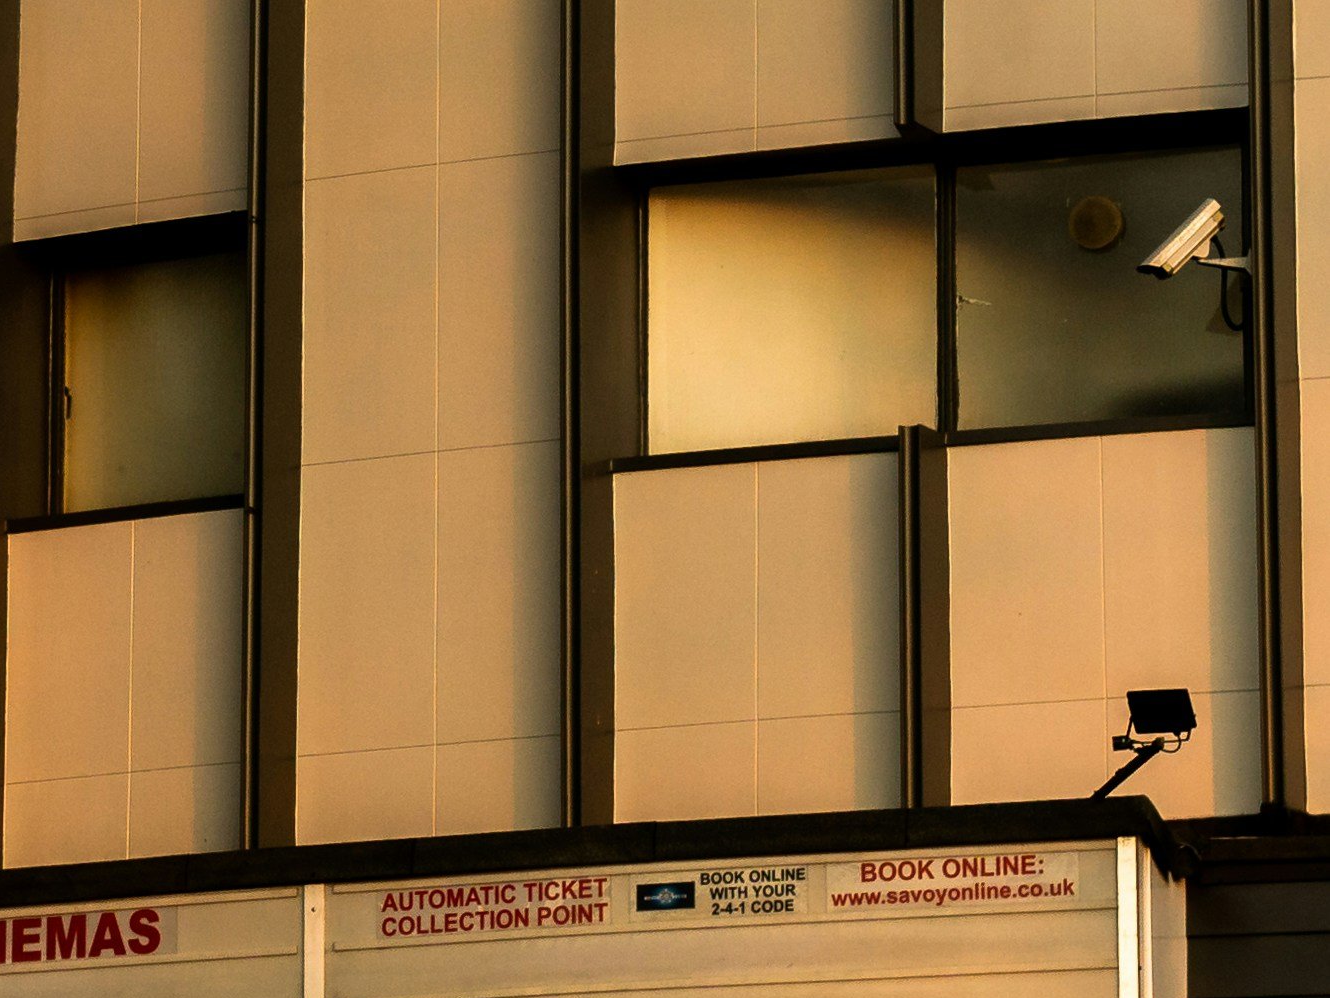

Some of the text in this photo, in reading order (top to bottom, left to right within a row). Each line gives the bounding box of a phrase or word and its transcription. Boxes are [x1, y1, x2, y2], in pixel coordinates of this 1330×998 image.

[700, 867, 806, 885] BOOK ONLINE
[860, 854, 1044, 883] BOOK ONLINE:
[381, 877, 608, 913] AUTOMATIC TICKET
[709, 883, 797, 900] WITH YOUR
[831, 878, 1075, 906] www.savoyonline.co.uk
[381, 903, 608, 937] COLLECTION POINT
[711, 899, 794, 916] 2-4-1 CODE
